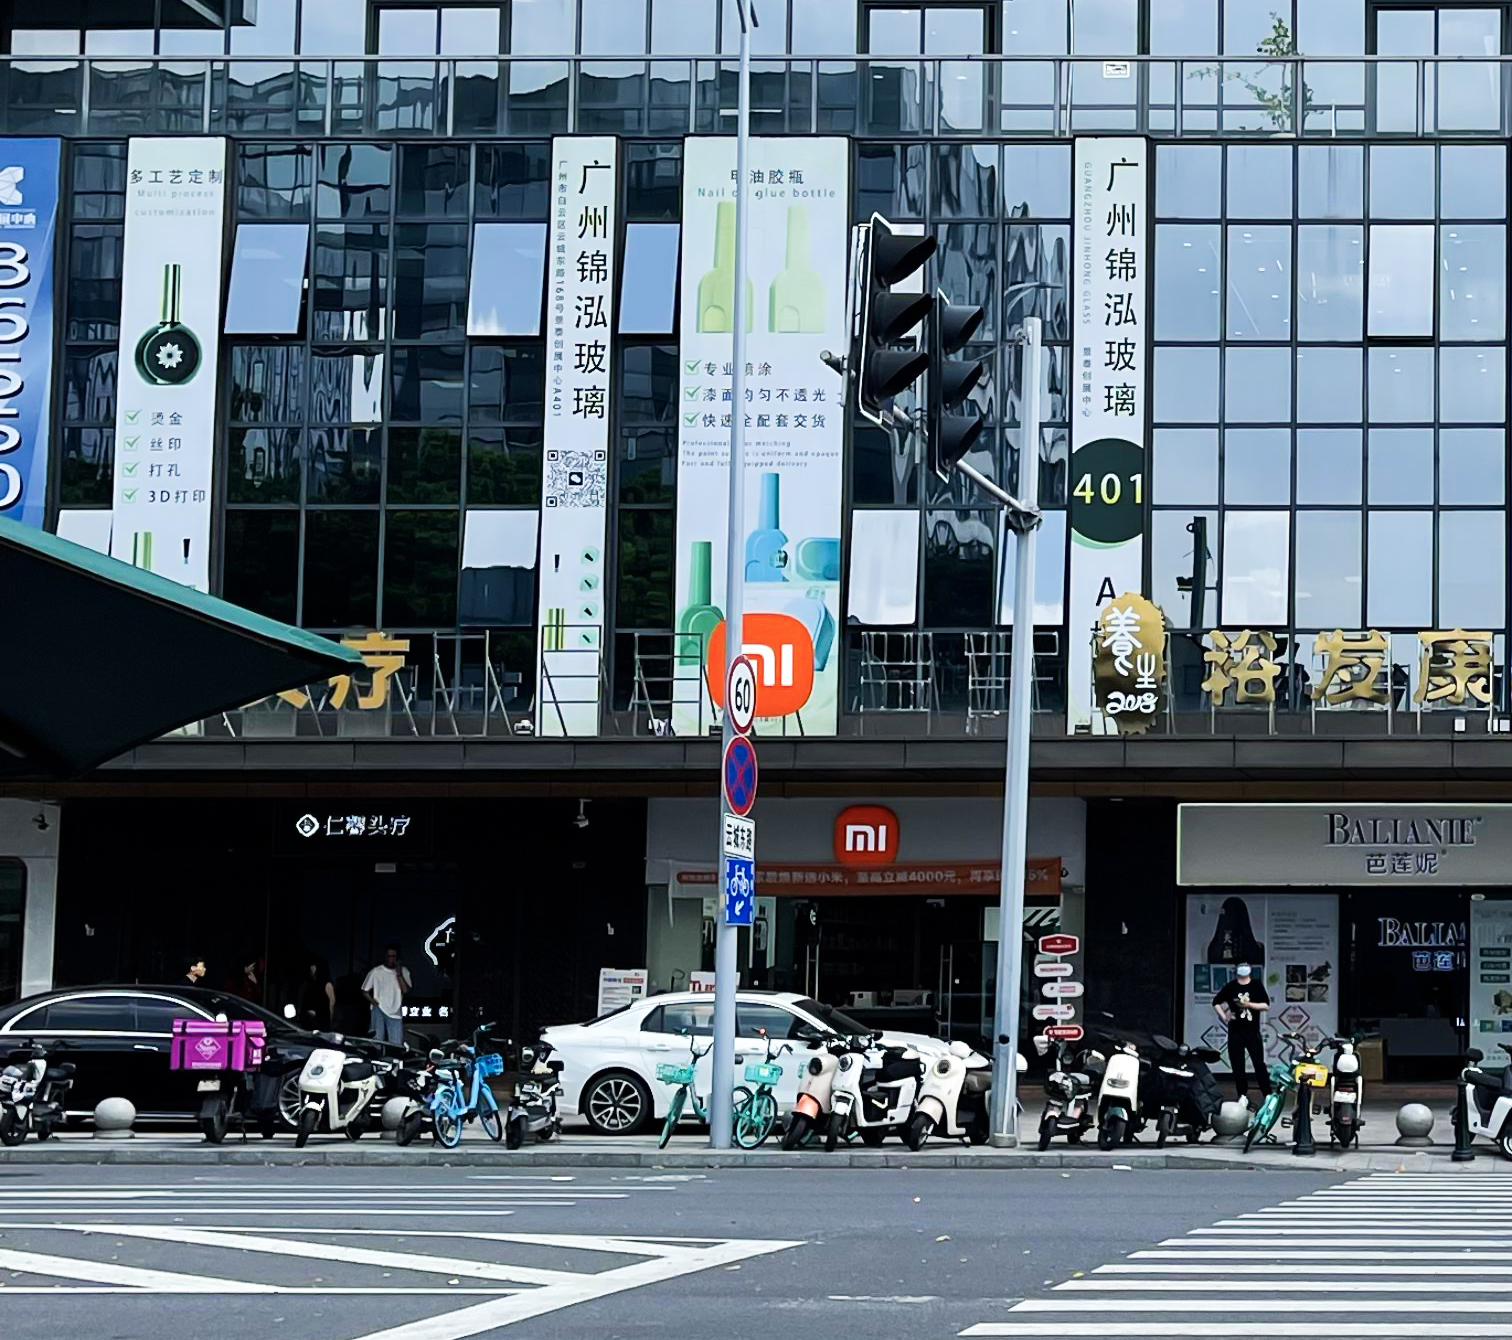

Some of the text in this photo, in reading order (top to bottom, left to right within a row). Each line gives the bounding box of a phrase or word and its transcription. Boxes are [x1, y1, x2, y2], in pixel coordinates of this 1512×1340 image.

[130, 168, 223, 184] 多工艺定制
[698, 188, 836, 200] Nail glue bottle
[572, 159, 611, 420] 广州锦泓玻璃
[1104, 157, 1139, 417] 广州锦泓玻璃
[150, 411, 183, 426] 烫金
[148, 463, 181, 477] 打孔
[1073, 473, 1144, 504] 401
[735, 677, 750, 714] 60
[1365, 852, 1440, 876] 芭莲妮
